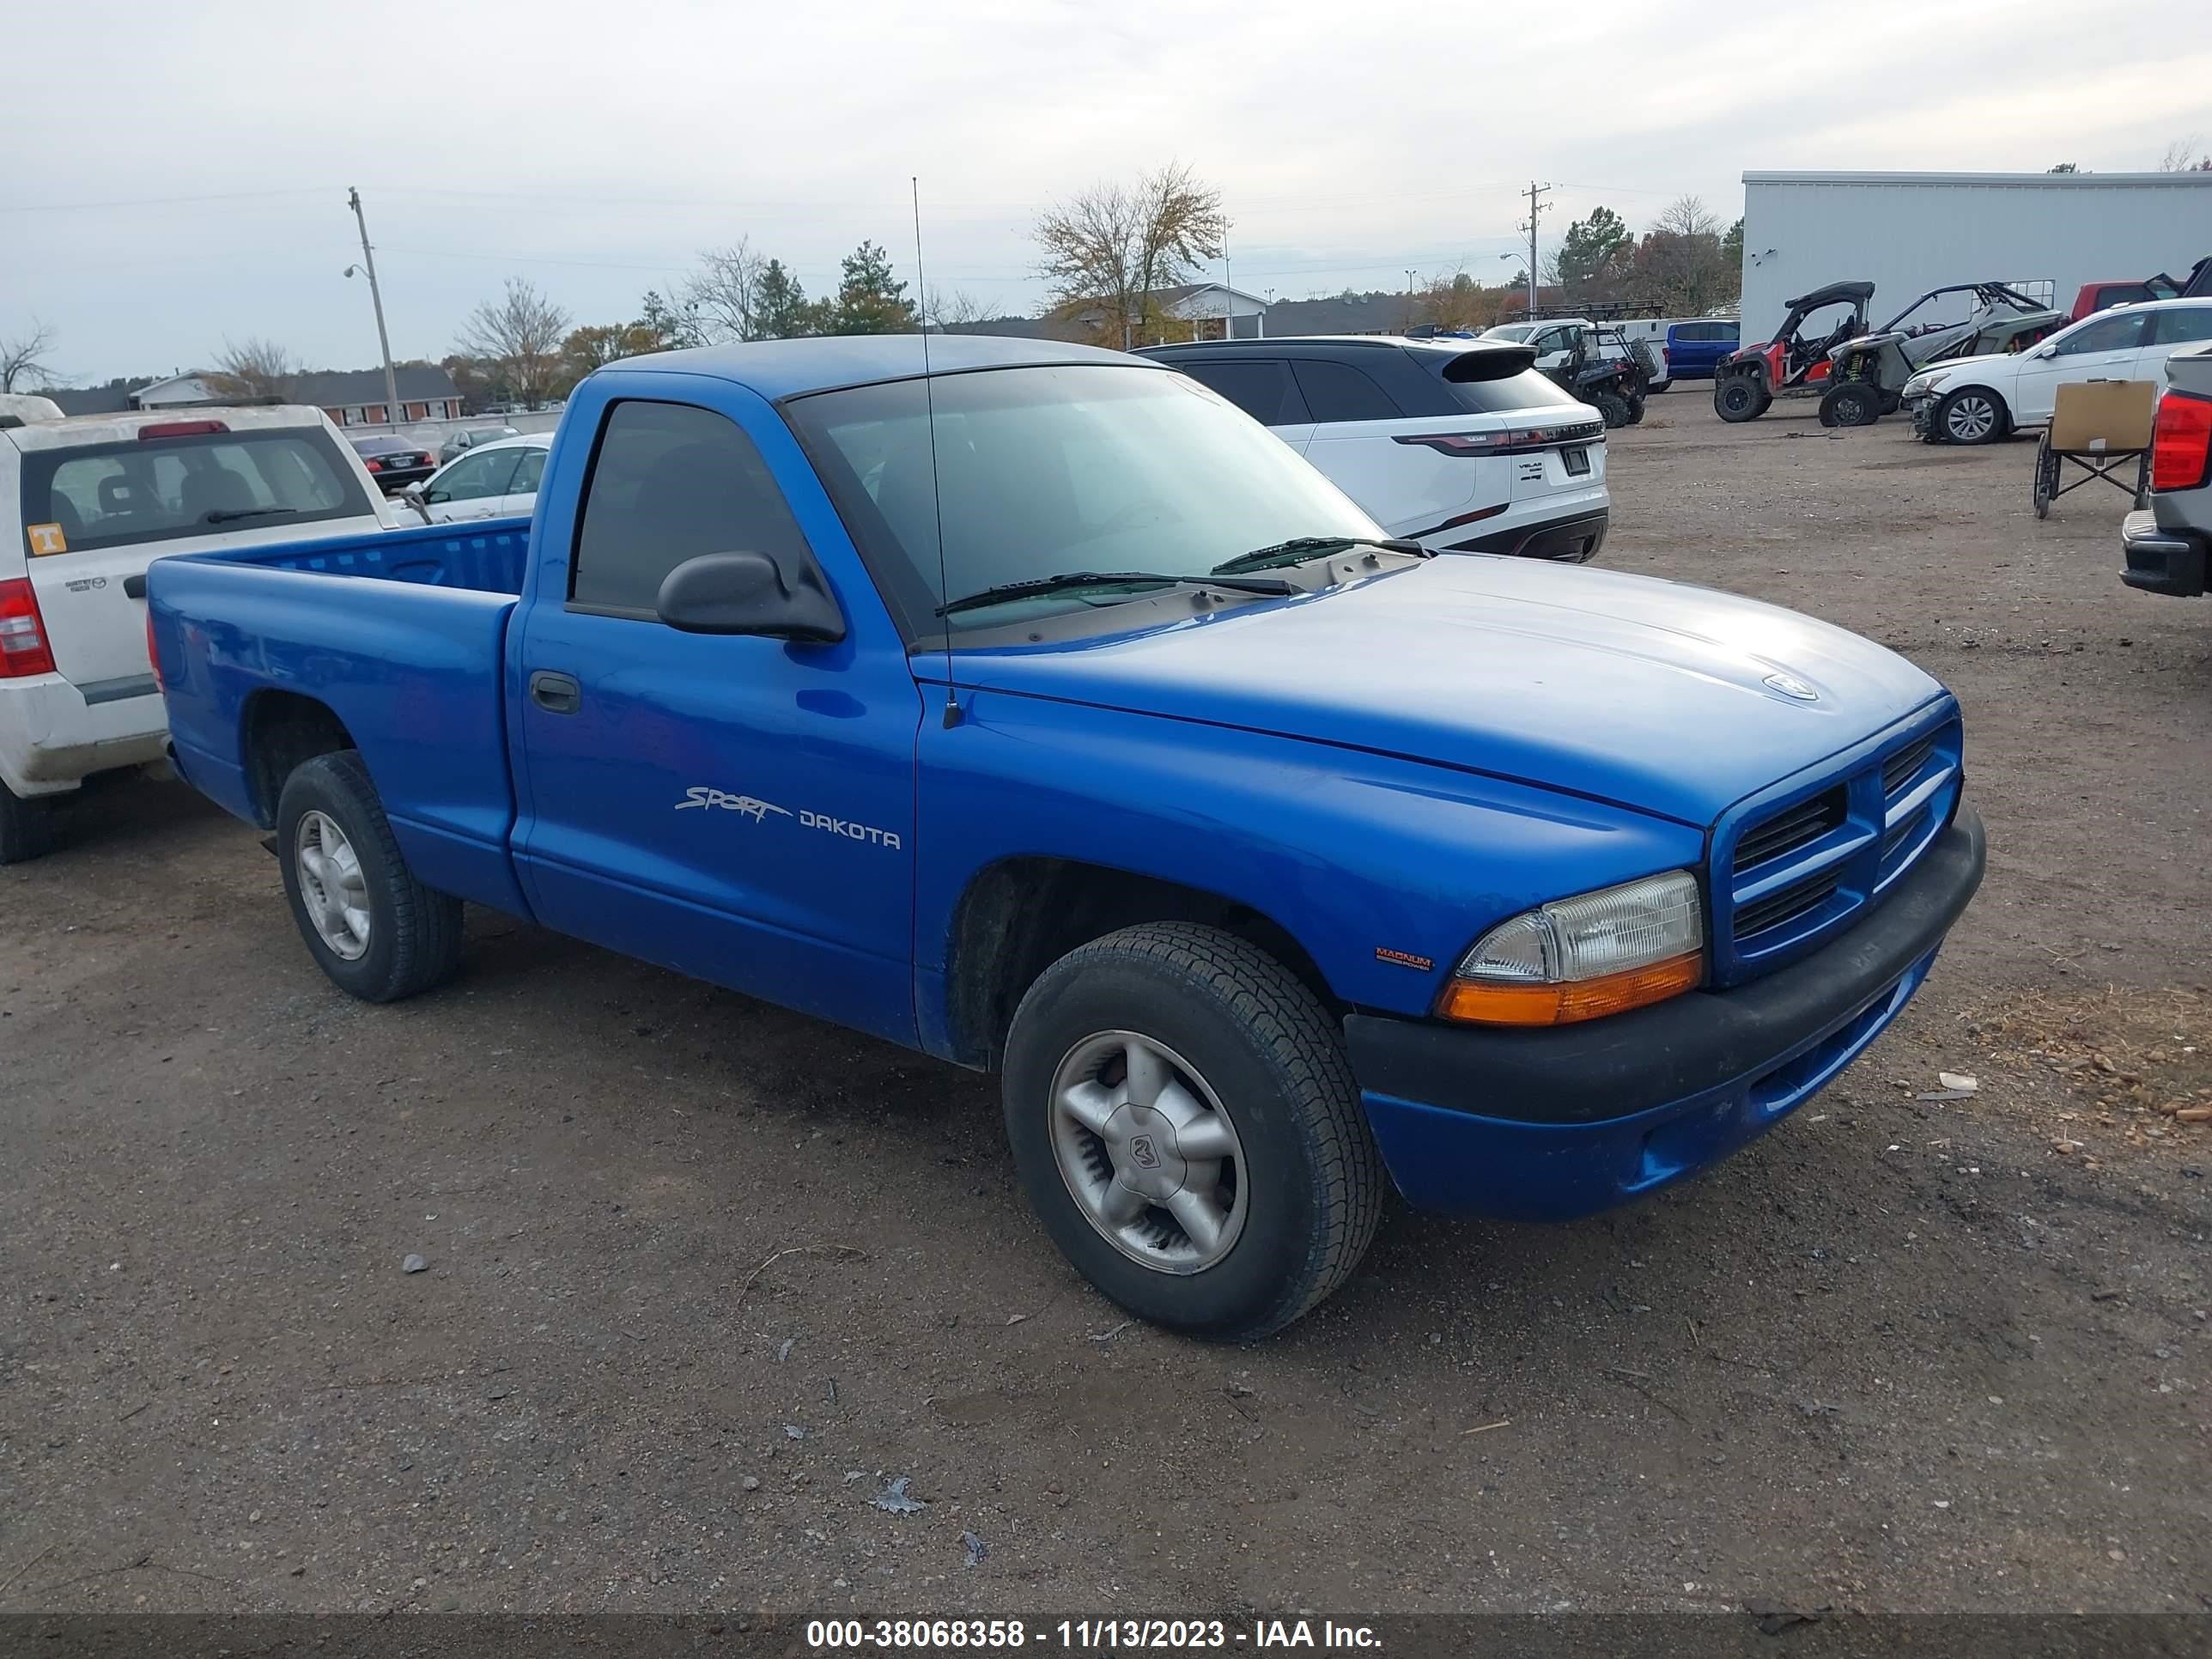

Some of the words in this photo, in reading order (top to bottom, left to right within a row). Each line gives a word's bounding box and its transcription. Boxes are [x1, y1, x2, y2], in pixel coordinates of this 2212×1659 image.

[674, 787, 793, 823] SPORT
[799, 810, 901, 850] DAKOTA
[1376, 947, 1431, 967] MAGNUM
[1402, 960, 1430, 971] POWER
